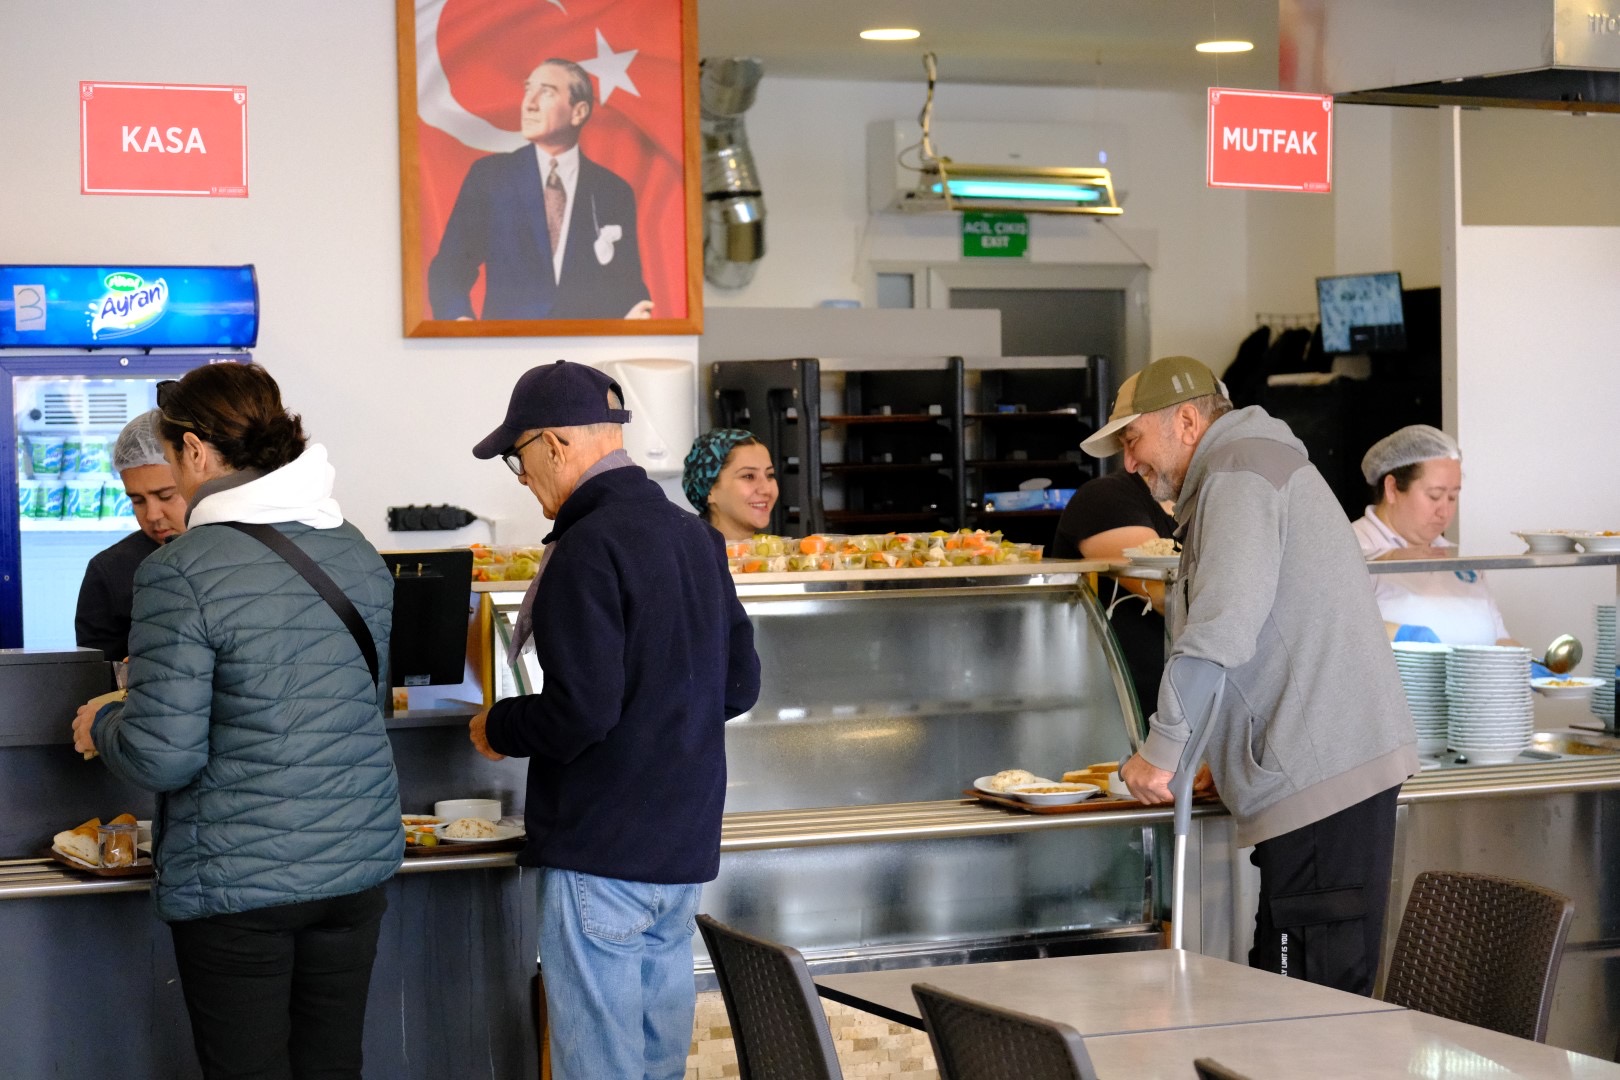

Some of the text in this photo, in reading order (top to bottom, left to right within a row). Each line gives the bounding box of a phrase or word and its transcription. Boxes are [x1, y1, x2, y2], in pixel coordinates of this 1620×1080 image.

[122, 126, 207, 154] KASA
[1223, 126, 1318, 155] MUTFAK
[981, 236, 1009, 248] EXIT
[18, 288, 44, 323] 3
[101, 286, 161, 319] Ayran
